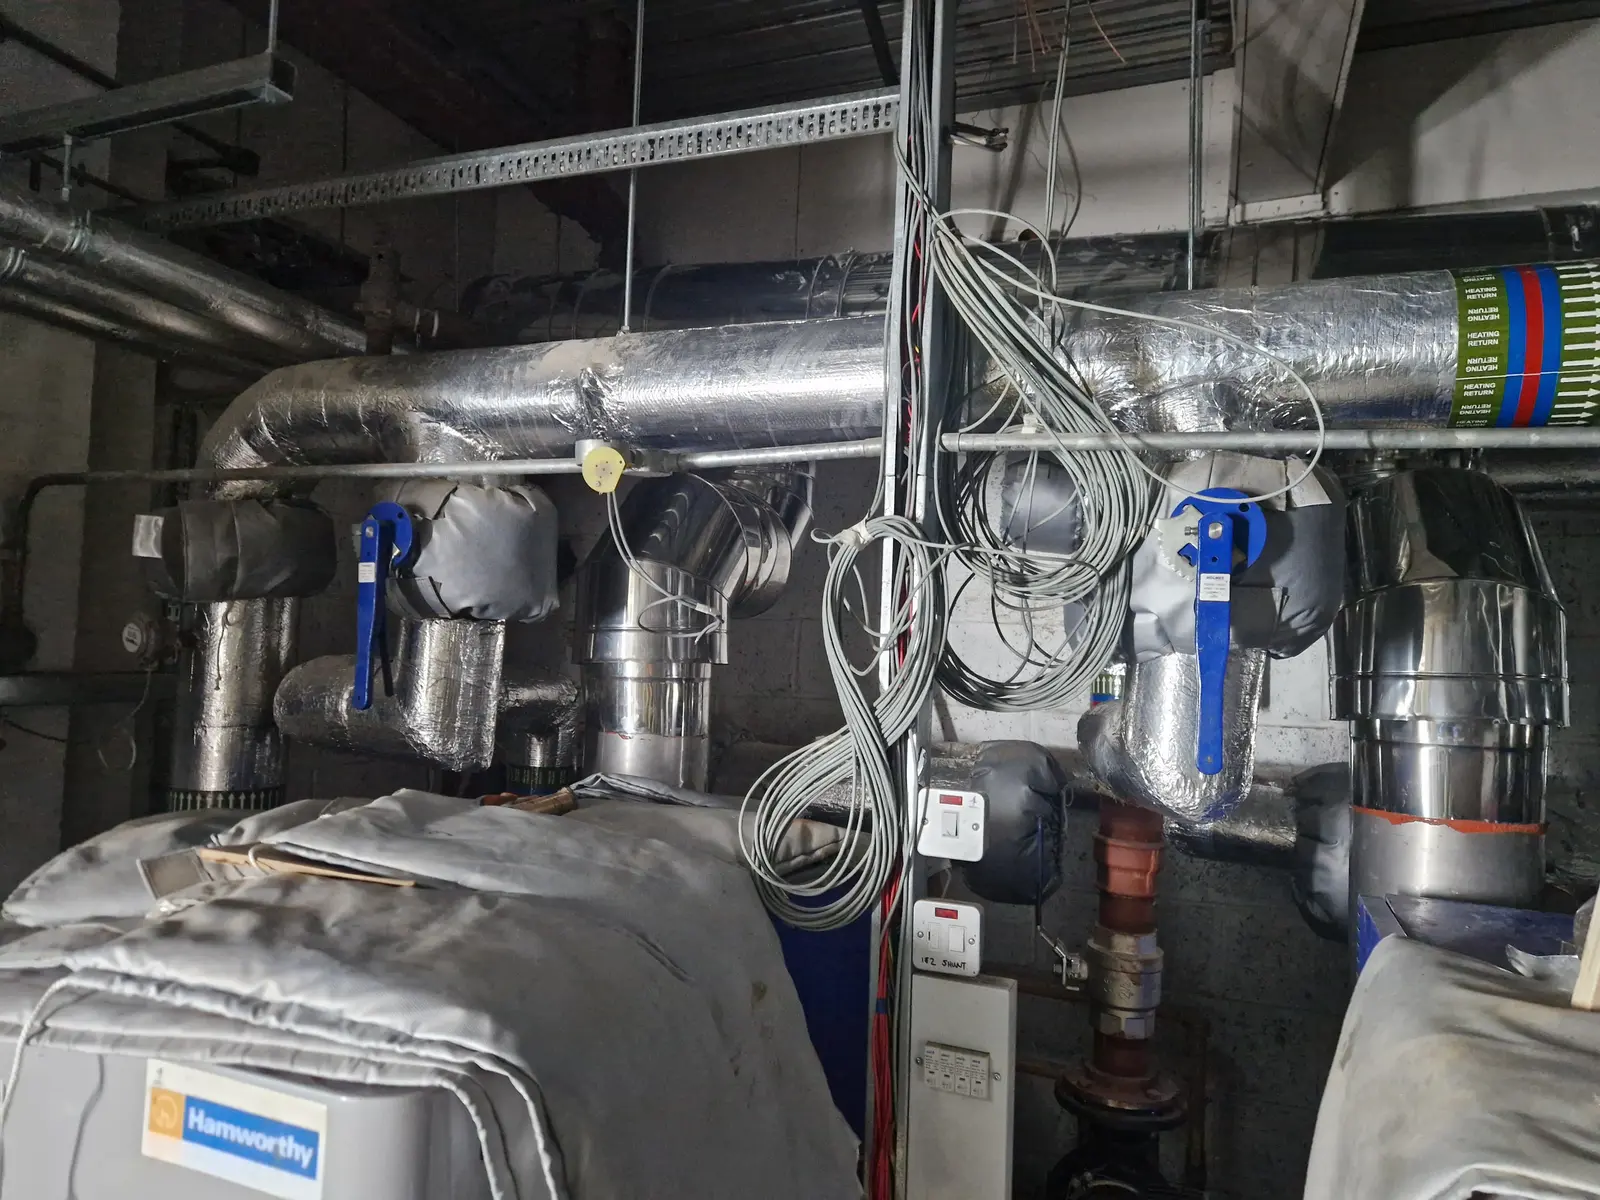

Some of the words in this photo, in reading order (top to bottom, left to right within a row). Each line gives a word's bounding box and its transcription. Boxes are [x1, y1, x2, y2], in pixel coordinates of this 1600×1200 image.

[1468, 339, 1499, 347] RETURN
[942, 960, 966, 970] SHUNT
[188, 1106, 313, 1169] Hamworthy
